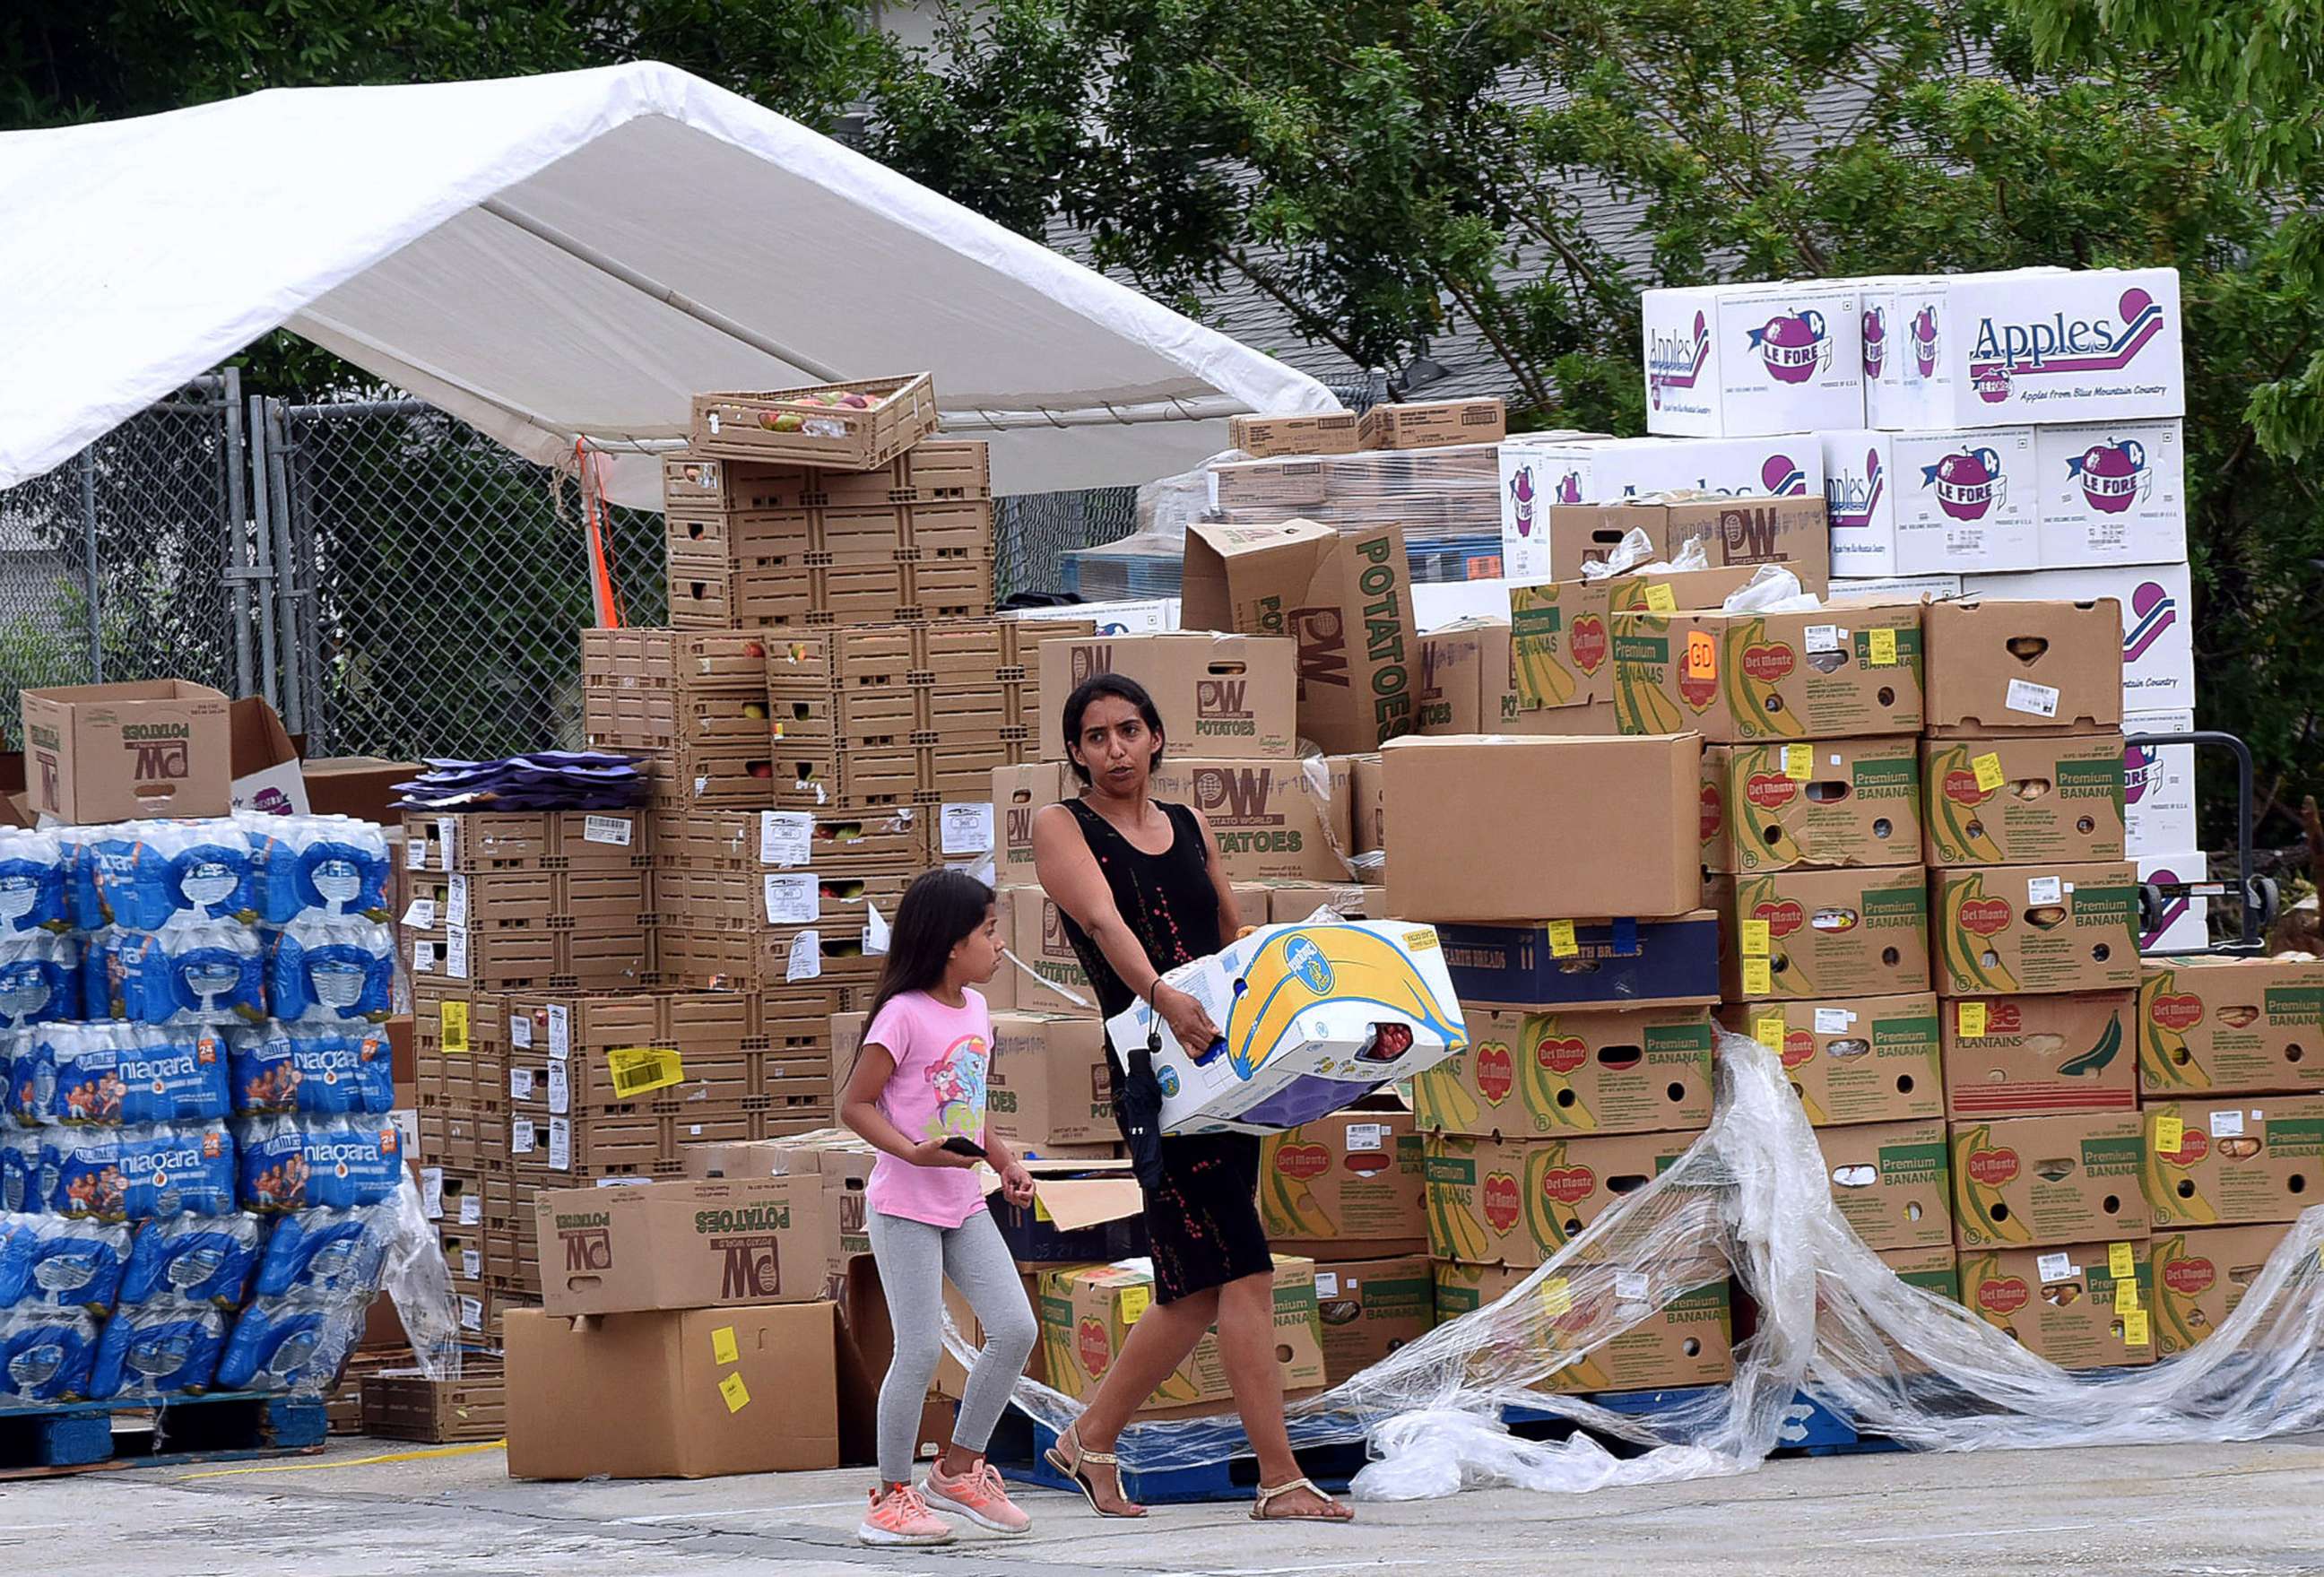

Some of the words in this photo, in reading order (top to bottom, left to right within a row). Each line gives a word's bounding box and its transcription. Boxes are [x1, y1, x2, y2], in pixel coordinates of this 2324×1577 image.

[1973, 313, 2112, 368] Apples
[1651, 328, 1691, 380] Apples
[1764, 346, 1779, 363] LE
[1783, 344, 1819, 364] FORE
[2020, 391, 2047, 403] Apples
[2050, 390, 2071, 400] from
[2074, 387, 2092, 398] Blue
[2094, 386, 2132, 397] Mountain
[2134, 386, 2167, 396] Country
[1984, 449, 1998, 472] 4
[2129, 443, 2143, 466] 4
[1938, 481, 1953, 498] LE
[1957, 484, 1992, 503] FORE
[2083, 473, 2098, 491] LE
[2103, 476, 2137, 494] FORE
[1721, 507, 1777, 558] PW
[1357, 536, 1414, 748] POTATOES
[1516, 637, 1558, 656] BANANAS
[1616, 640, 1657, 660] Premium
[1745, 654, 1760, 668] Del
[1762, 653, 1791, 667] Monte
[1617, 663, 1664, 684] BANANAS
[2146, 677, 2178, 689] Country
[1196, 680, 1246, 718] PW
[122, 723, 189, 740] POTATOES
[1196, 720, 1255, 736] POTATOES
[134, 741, 189, 780] PW
[1856, 772, 1909, 784] Premium
[2060, 773, 2112, 784] Premium
[2124, 769, 2149, 787] ORE
[1192, 768, 1271, 817] PW
[1749, 784, 1763, 795] Del
[1765, 782, 1793, 793] Monte
[1238, 815, 1273, 826] WORLD
[1215, 830, 1303, 854] TATOES
[1866, 902, 1916, 914] Premium
[1962, 909, 1976, 921] Del
[1978, 908, 2008, 920] Monte
[2074, 900, 2127, 913] Premium
[1771, 910, 1801, 923] Monte
[1033, 960, 1091, 985] POTATOE
[2155, 1004, 2168, 1017] Del
[2170, 1002, 2200, 1016] Monte
[2268, 1001, 2320, 1012] Premium
[1648, 1037, 1699, 1050] Premium
[1876, 1031, 1927, 1044] Premium
[1955, 1035, 2023, 1049] PLANTAINS
[1539, 1050, 1555, 1060] Del
[1556, 1048, 1585, 1060] Monte
[119, 1055, 195, 1081] niagara
[986, 1090, 1018, 1113] TOES
[2182, 1139, 2207, 1151] onte
[2269, 1132, 2321, 1144] Premium
[120, 1149, 201, 1174] niagara
[303, 1143, 379, 1164] niagara
[2086, 1150, 2138, 1163] Premium
[1428, 1162, 1465, 1180] Premium
[1883, 1157, 1936, 1171] Premium
[1971, 1159, 1986, 1172] Del
[1987, 1158, 2016, 1171] Monte
[1546, 1178, 1560, 1189] Del
[1562, 1176, 1592, 1188] Monte
[1429, 1185, 1473, 1206] BANANAS
[1485, 1190, 1496, 1207] Del
[1496, 1192, 1518, 1209] Monte
[556, 1211, 611, 1230] POTATOES
[695, 1207, 791, 1235] POTATOES
[565, 1229, 612, 1271] PW
[721, 1236, 780, 1299] PW
[2166, 1269, 2182, 1280] Del
[2183, 1267, 2213, 1280] Monte
[1979, 1288, 1995, 1300] Del
[1997, 1287, 2026, 1299] Monte
[1272, 1299, 1308, 1313] mium
[1273, 1310, 1318, 1328] NANAS
